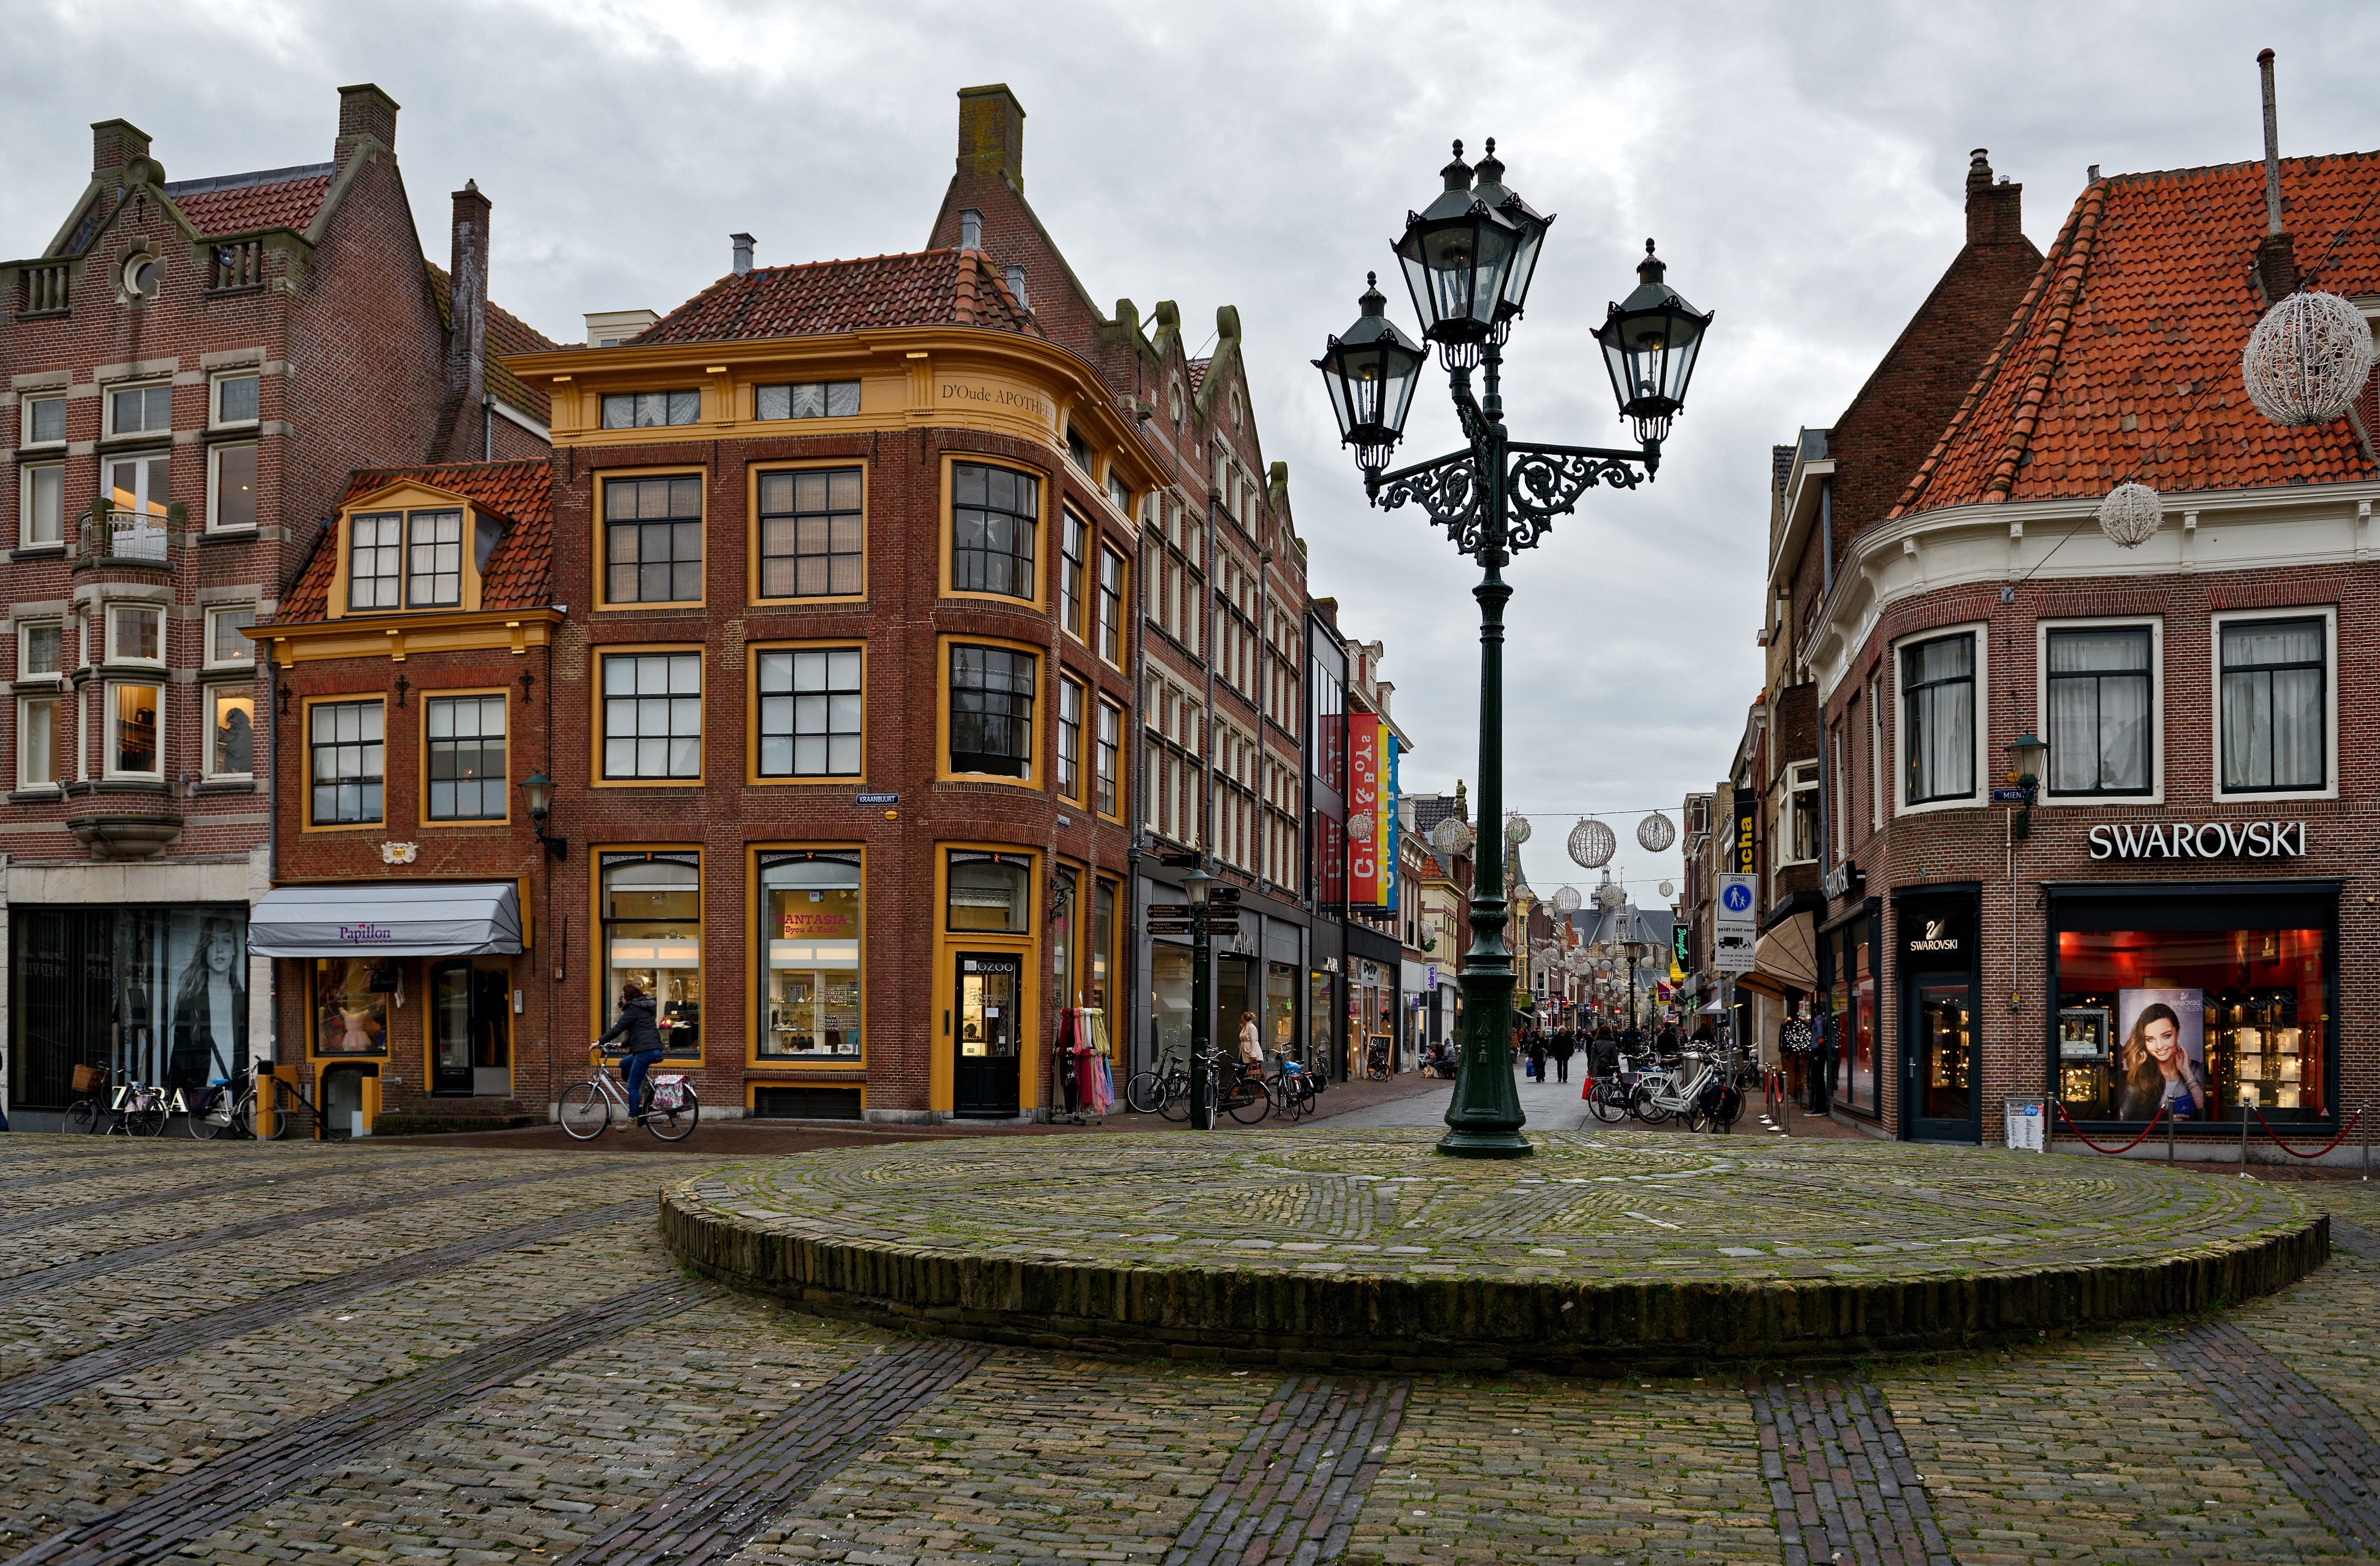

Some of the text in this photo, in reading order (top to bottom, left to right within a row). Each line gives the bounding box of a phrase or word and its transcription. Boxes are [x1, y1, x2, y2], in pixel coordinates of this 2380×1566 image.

[942, 384, 1056, 422] D'Oude APOTHEEK
[1738, 817, 1753, 874] acha
[2089, 822, 2308, 859] SWAROVSKI
[776, 914, 847, 924] FANTASIA
[339, 924, 391, 944] Papillon
[785, 926, 805, 935] Byou
[1232, 932, 1254, 956] ZARA
[1675, 928, 1688, 960] Douglas
[1910, 940, 1958, 951] SWAROVSKI
[978, 962, 1013, 971] OZOO
[1326, 956, 1338, 973] ZARA
[1372, 1039, 1389, 1049] ALE
[112, 1086, 188, 1112] ZRA
